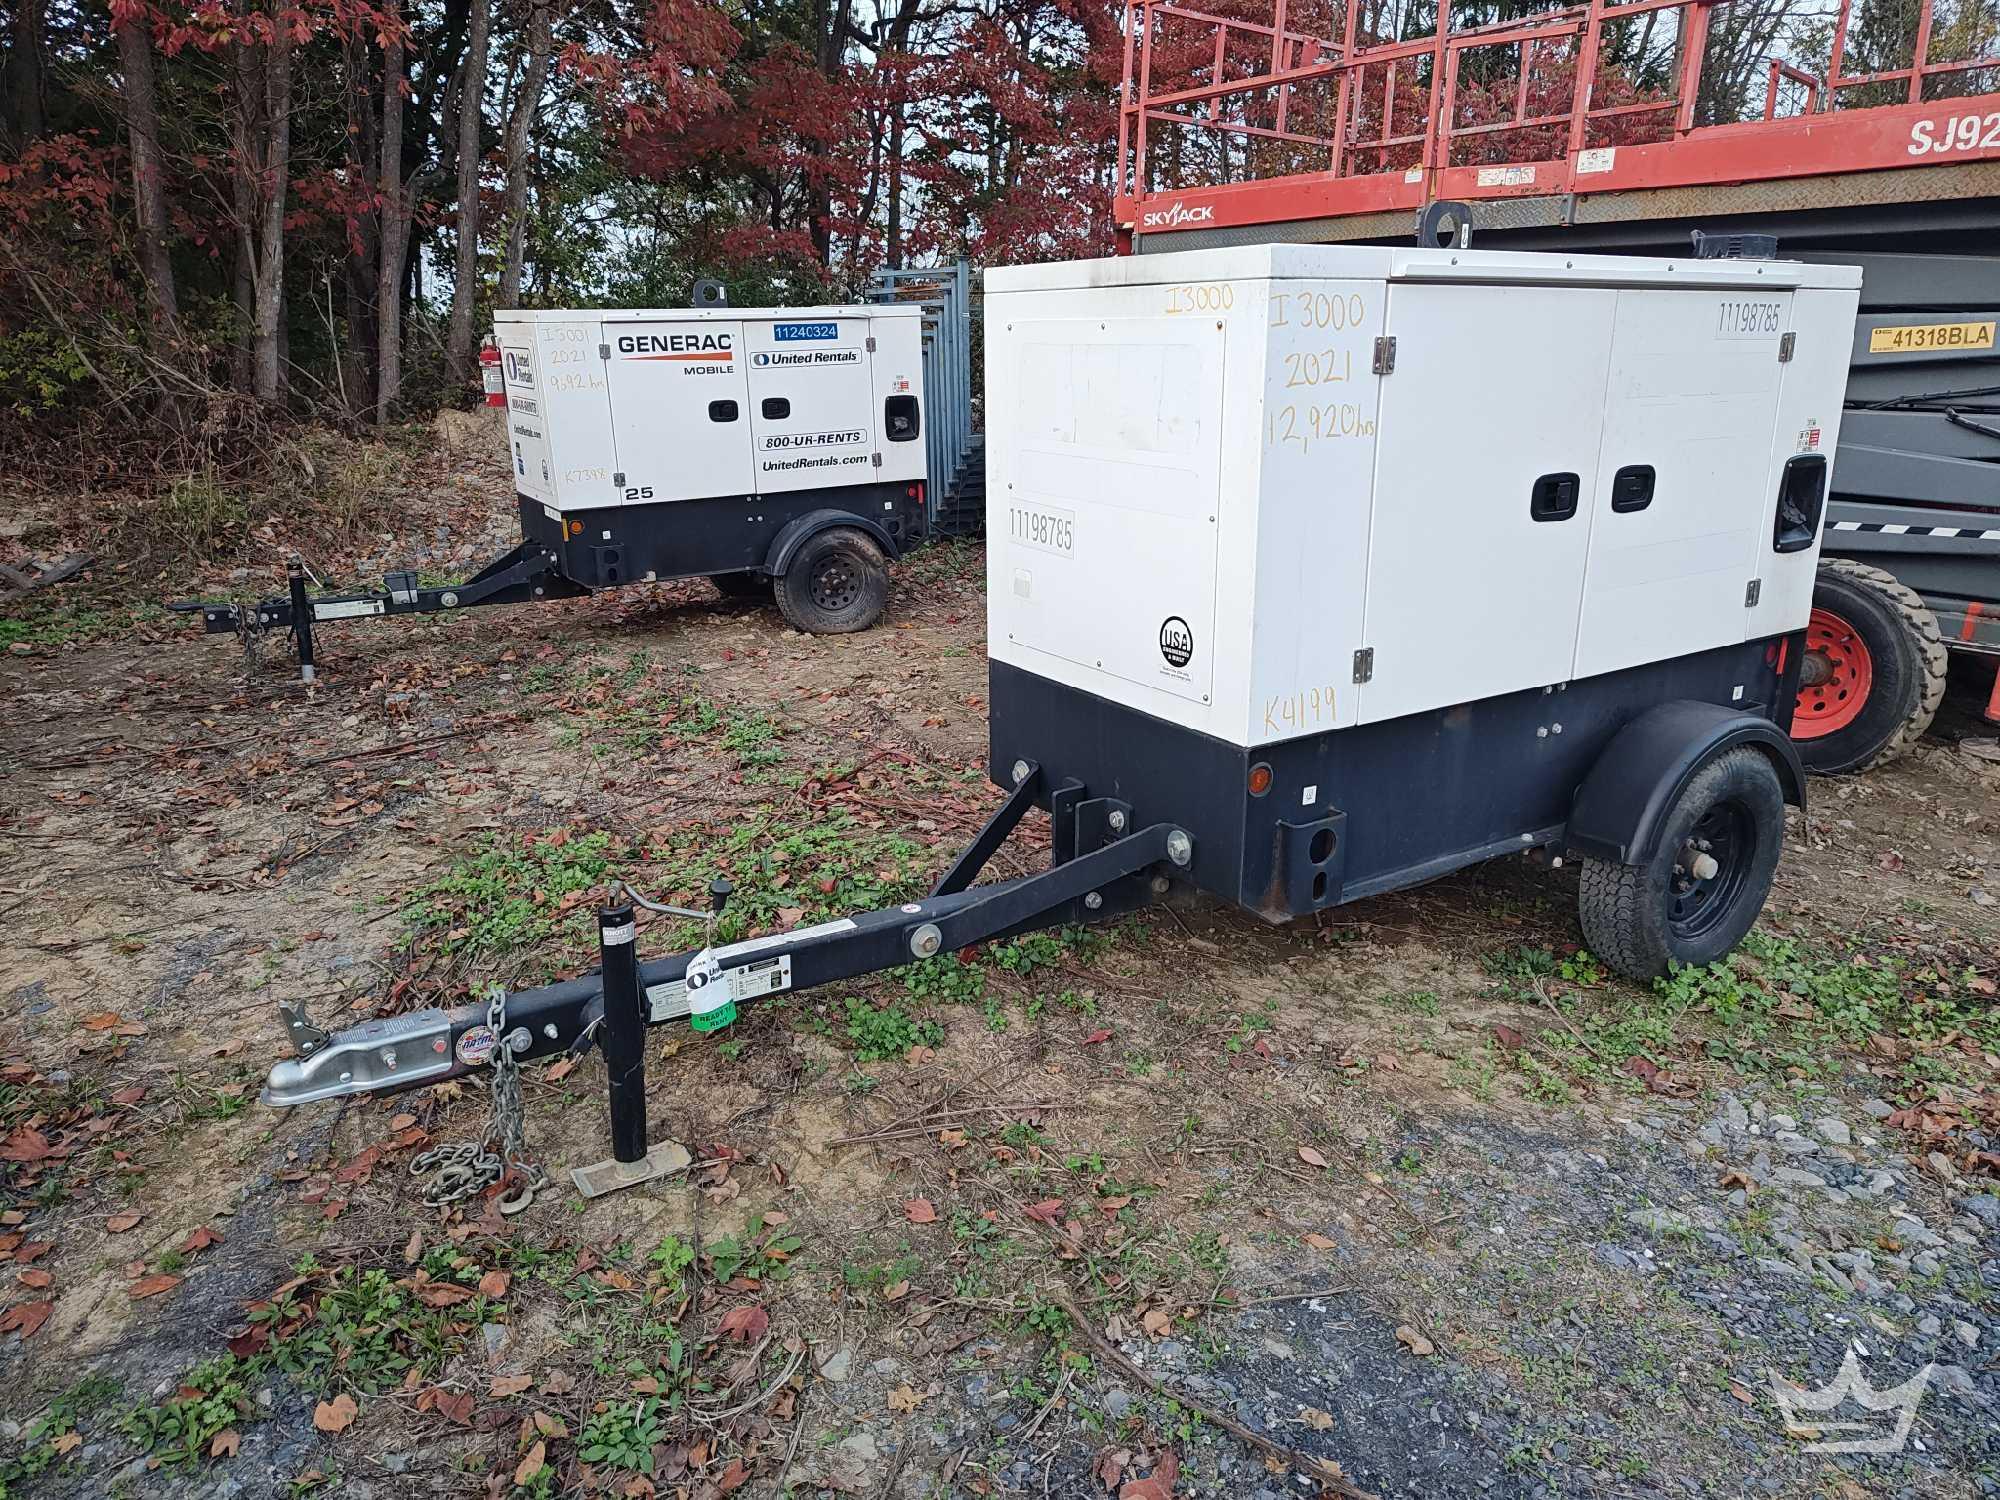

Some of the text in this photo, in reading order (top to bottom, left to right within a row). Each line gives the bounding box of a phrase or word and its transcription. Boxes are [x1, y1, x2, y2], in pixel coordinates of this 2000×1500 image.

[1143, 201, 1214, 227] SKYJACK
[1165, 284, 1233, 313] I3000
[1720, 303, 1781, 332] 11198785
[618, 334, 733, 352] GENERAC
[775, 326, 837, 339] 11240324
[1893, 325, 1990, 347] 41318BLA
[772, 351, 857, 365] United Rentals
[1285, 350, 1350, 388] 2021
[684, 366, 734, 375] MOBILE
[766, 432, 860, 448] 800-UR-RENTS
[762, 455, 868, 471] UnitedRentals.com
[625, 487, 654, 500] 25
[1010, 508, 1072, 550] 11198785
[1164, 628, 1188, 651] USA
[1264, 686, 1336, 736] K4199
